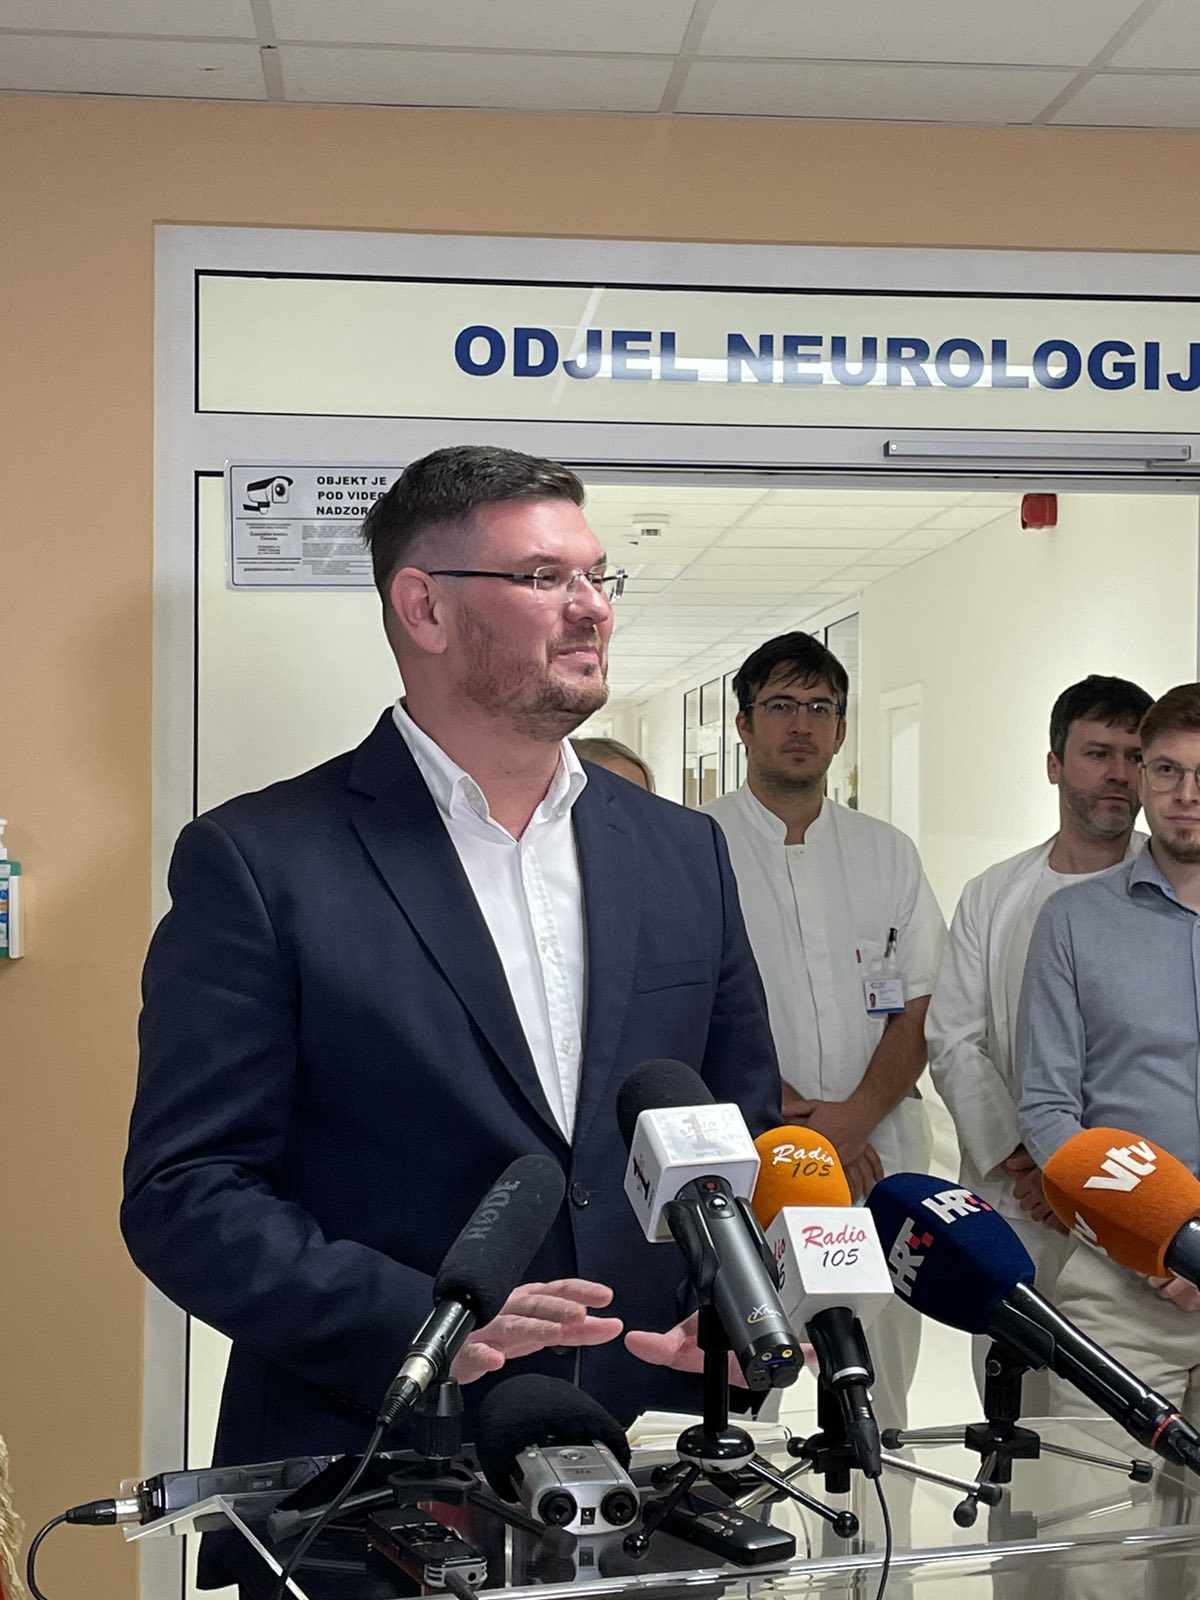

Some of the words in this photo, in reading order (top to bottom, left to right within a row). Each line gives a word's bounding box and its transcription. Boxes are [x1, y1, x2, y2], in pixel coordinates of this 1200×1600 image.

[454, 325, 698, 381] ODJEL
[727, 333, 1200, 392] NEUROLOGIJ
[316, 476, 368, 486] OBJEKT
[371, 477, 387, 486] JE
[317, 491, 343, 500] POD
[791, 1161, 832, 1178] 105
[802, 1224, 867, 1249] Radio
[823, 1248, 859, 1267] 105
